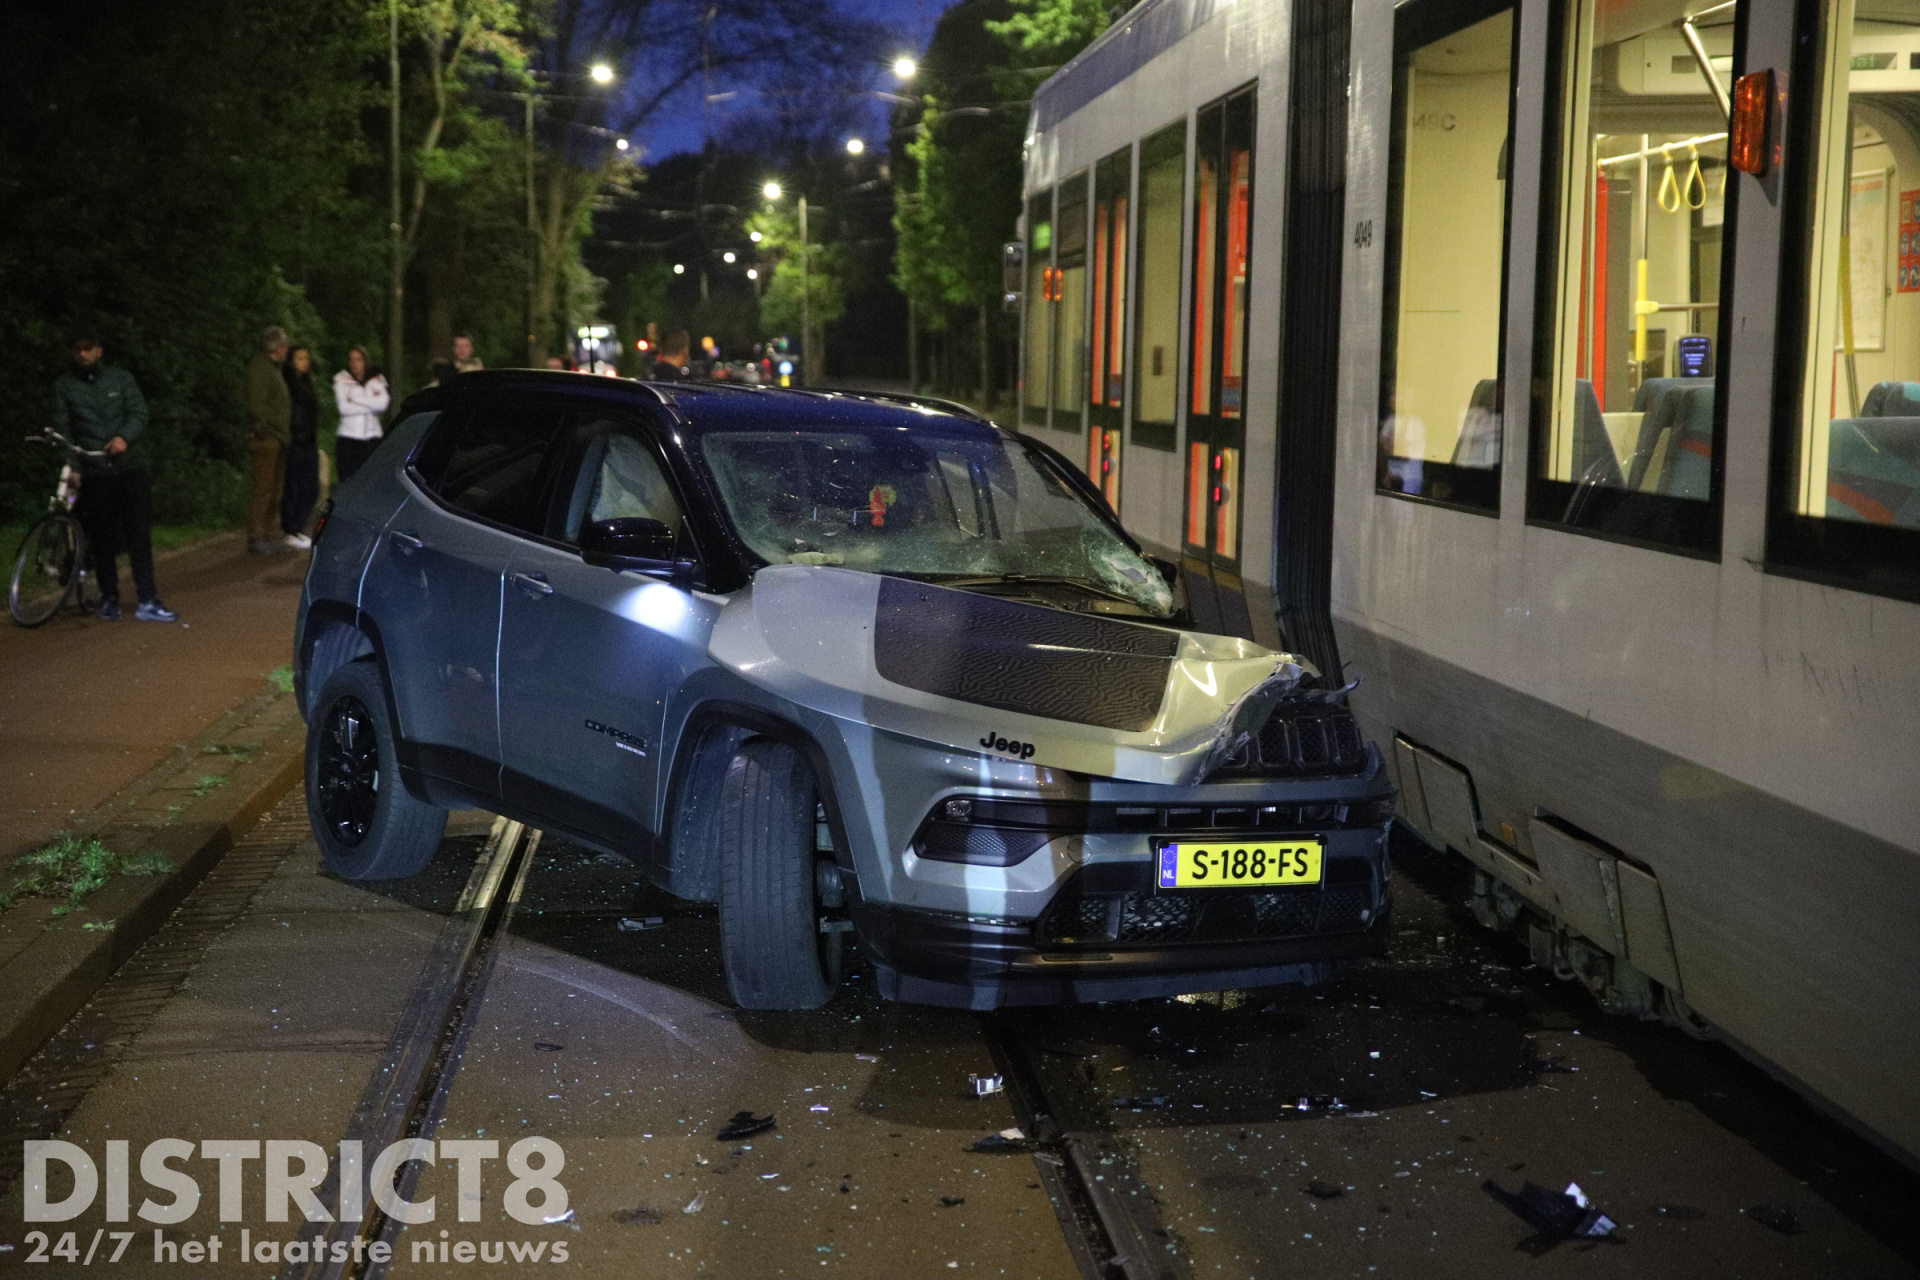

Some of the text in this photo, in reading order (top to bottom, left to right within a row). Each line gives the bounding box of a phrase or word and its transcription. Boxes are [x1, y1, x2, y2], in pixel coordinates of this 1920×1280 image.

[1354, 219, 1372, 249] 4049
[585, 719, 646, 748] COMPASS
[980, 731, 1035, 760] Jeep
[1163, 869, 1175, 879] NL
[1192, 848, 1308, 880] S-188-FS
